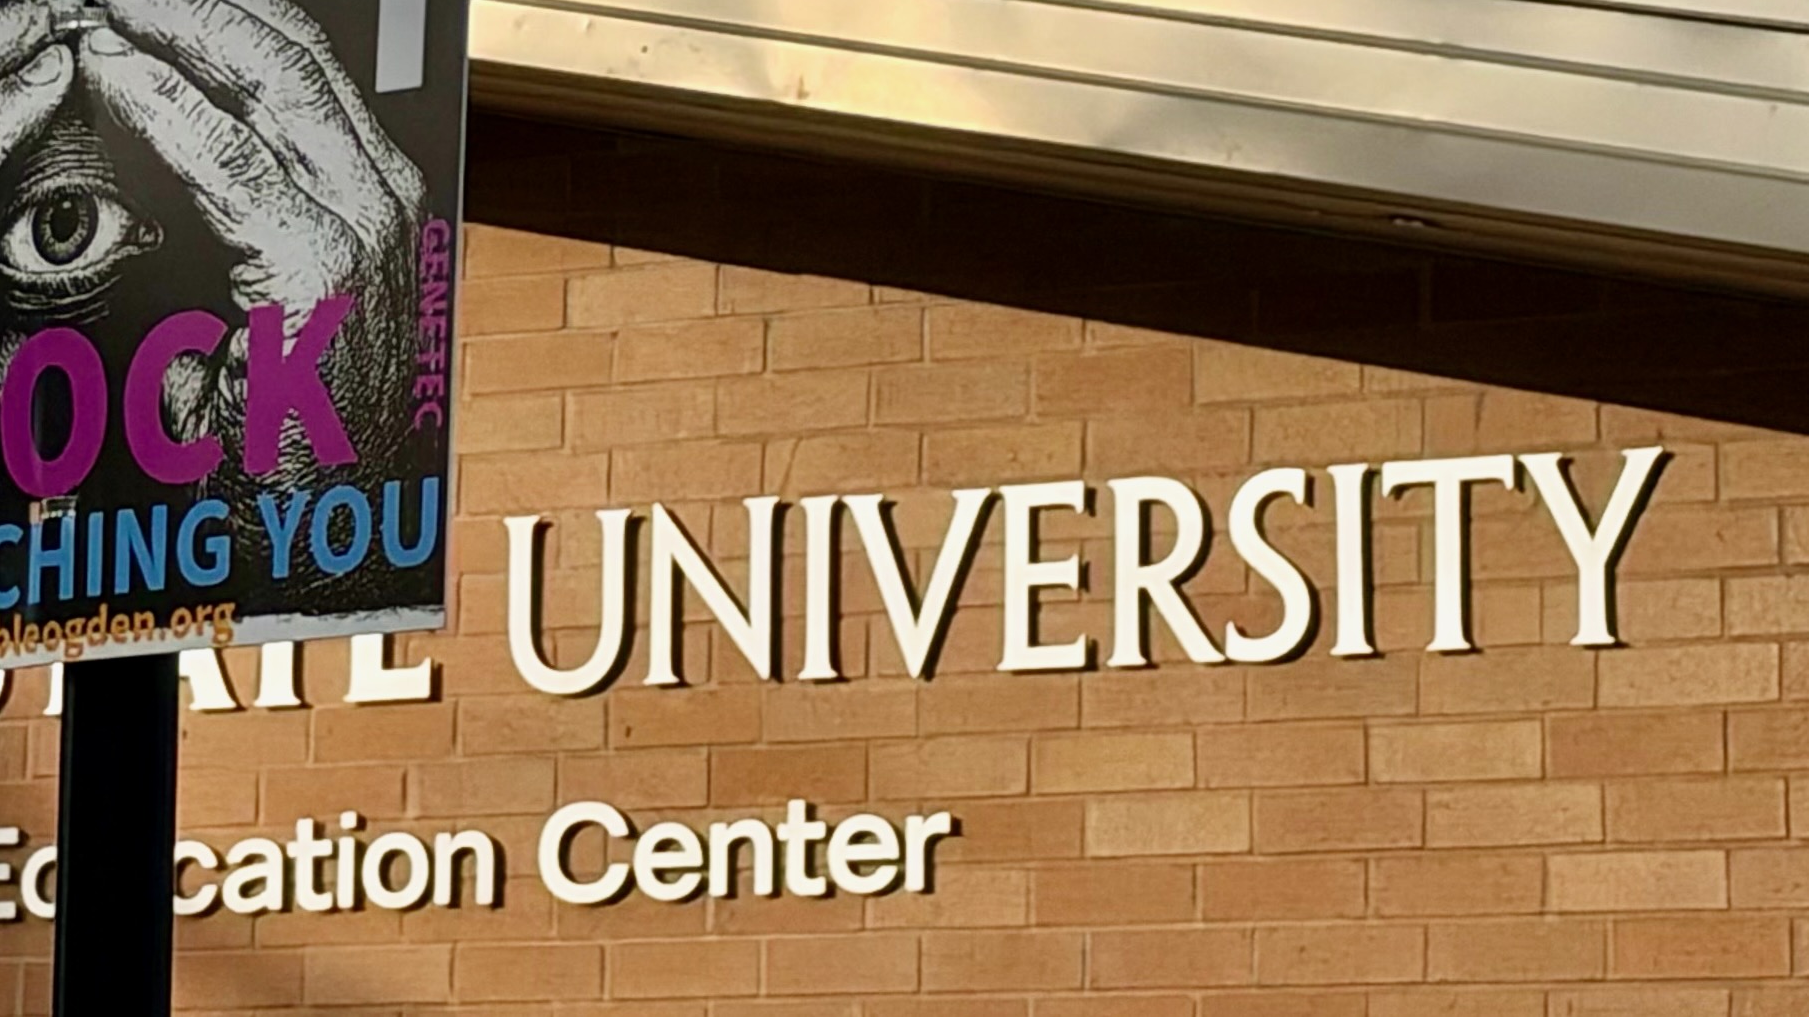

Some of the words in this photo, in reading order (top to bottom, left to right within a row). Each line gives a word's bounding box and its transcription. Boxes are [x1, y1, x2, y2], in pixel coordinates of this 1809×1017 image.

[414, 218, 450, 430] GENETEC
[258, 476, 439, 579] YOU
[505, 445, 1665, 693] UNIVERSITY
[537, 797, 952, 904] Center
